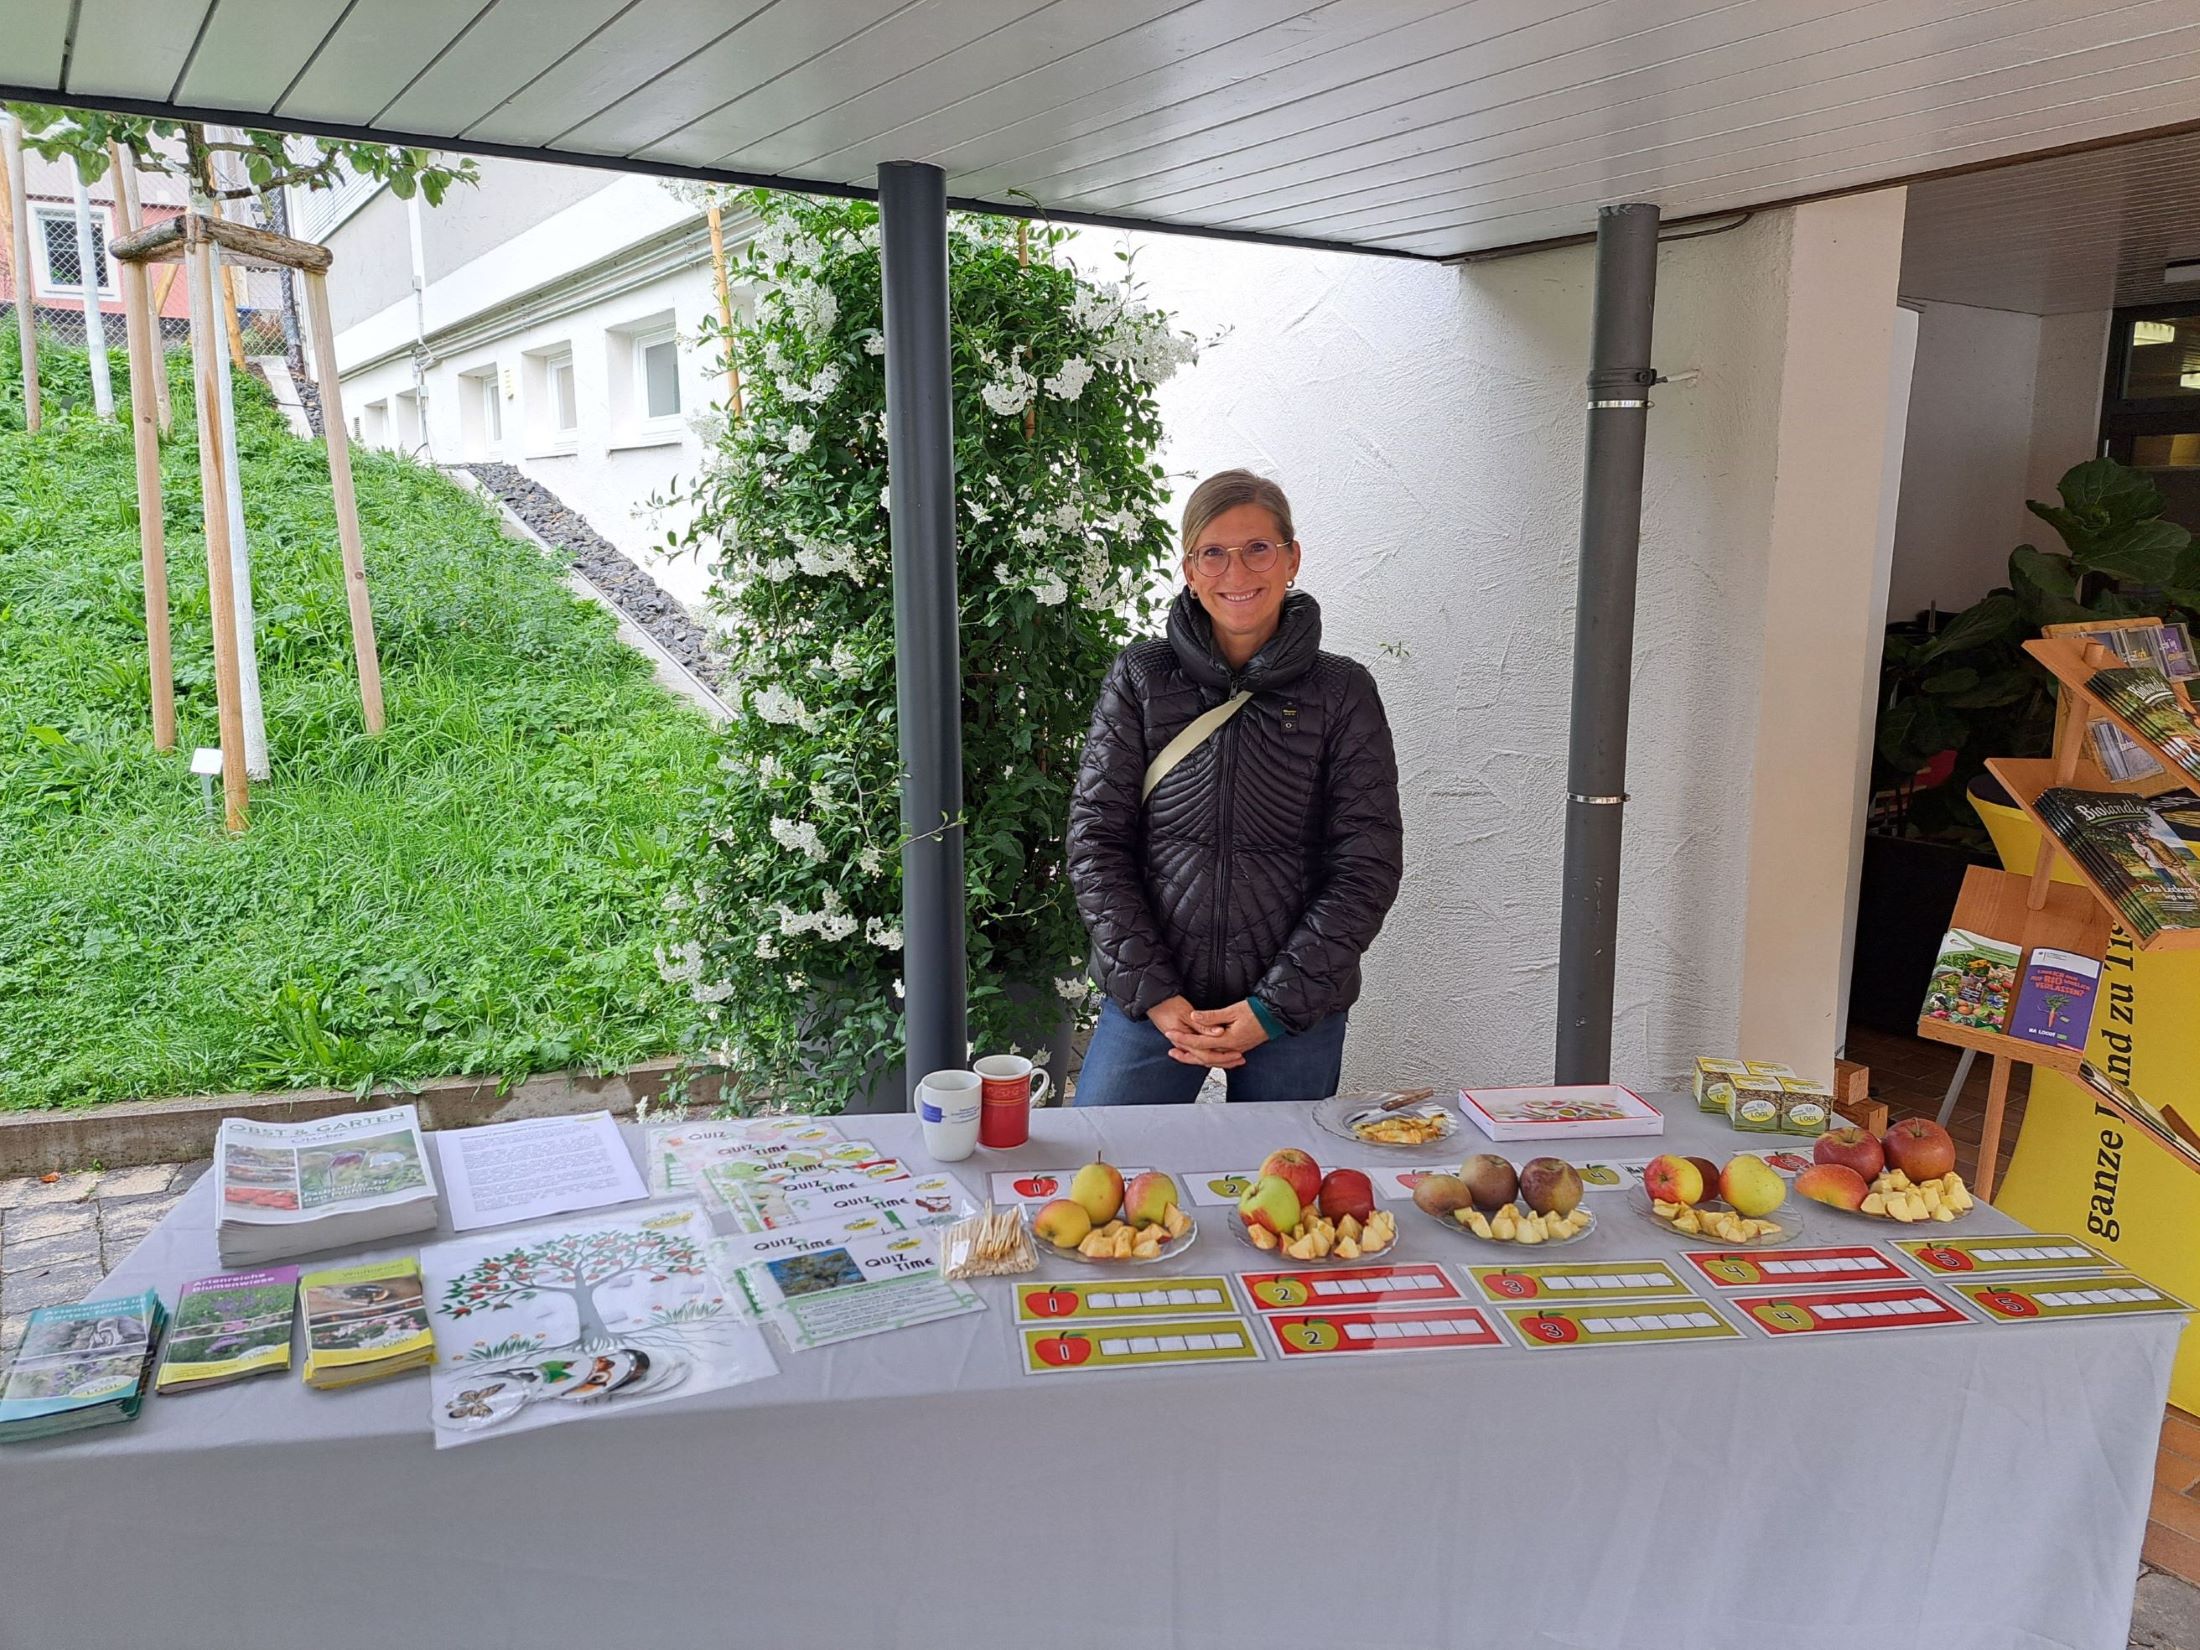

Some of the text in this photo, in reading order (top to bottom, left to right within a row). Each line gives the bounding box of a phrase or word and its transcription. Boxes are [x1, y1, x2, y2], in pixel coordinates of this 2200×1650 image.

[2074, 800, 2146, 821] Bioländle
[2044, 975, 2063, 986] BIO
[2087, 1129, 2124, 1243] ganze
[2110, 982, 2133, 1025] zu
[229, 1123, 287, 1137] OBST
[316, 1112, 406, 1133] GARTEN
[689, 1131, 727, 1141] QUIZ
[717, 1144, 755, 1156] QUIZ
[754, 1160, 794, 1172] QUIZ
[783, 1180, 823, 1192] QUIZ
[833, 1195, 872, 1209] QUIZ
[753, 1236, 798, 1251] QUIZ
[864, 1253, 909, 1267] QUIZ
[1935, 1254, 1958, 1266] 5
[1724, 1266, 1746, 1278] 4
[192, 1277, 275, 1292] Blumenwiese
[193, 1273, 266, 1287] Artenreiche
[1504, 1280, 1523, 1294] 3
[1274, 1287, 1293, 1301] 2
[1997, 1298, 2022, 1311] 5
[1775, 1311, 1800, 1324] 4
[1542, 1323, 1563, 1337] 3
[1303, 1330, 1323, 1345] 2
